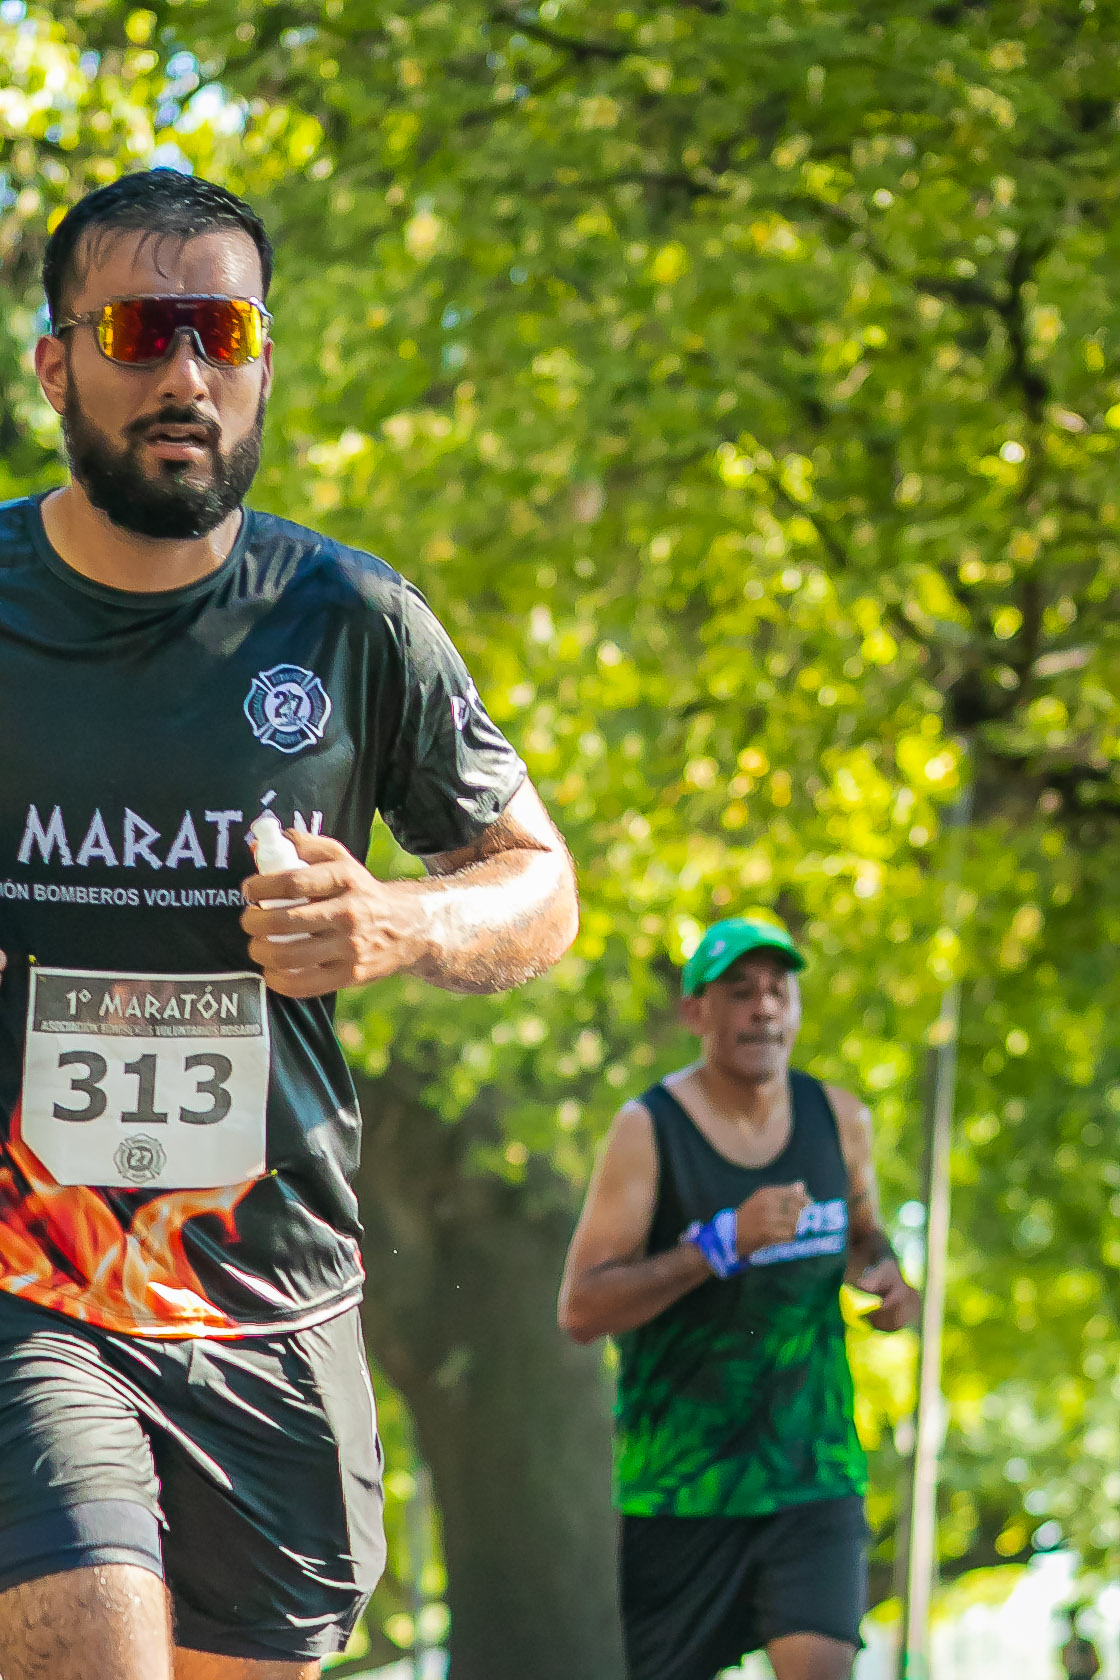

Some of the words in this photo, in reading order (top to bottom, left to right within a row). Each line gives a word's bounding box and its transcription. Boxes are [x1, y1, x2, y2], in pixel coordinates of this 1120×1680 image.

[33, 884, 140, 906] BOMBEROS
[143, 888, 250, 908] VOLUNTARI
[99, 984, 240, 1020] MARATÓN
[52, 1050, 233, 1125] 313
[130, 1149, 152, 1166] 27
